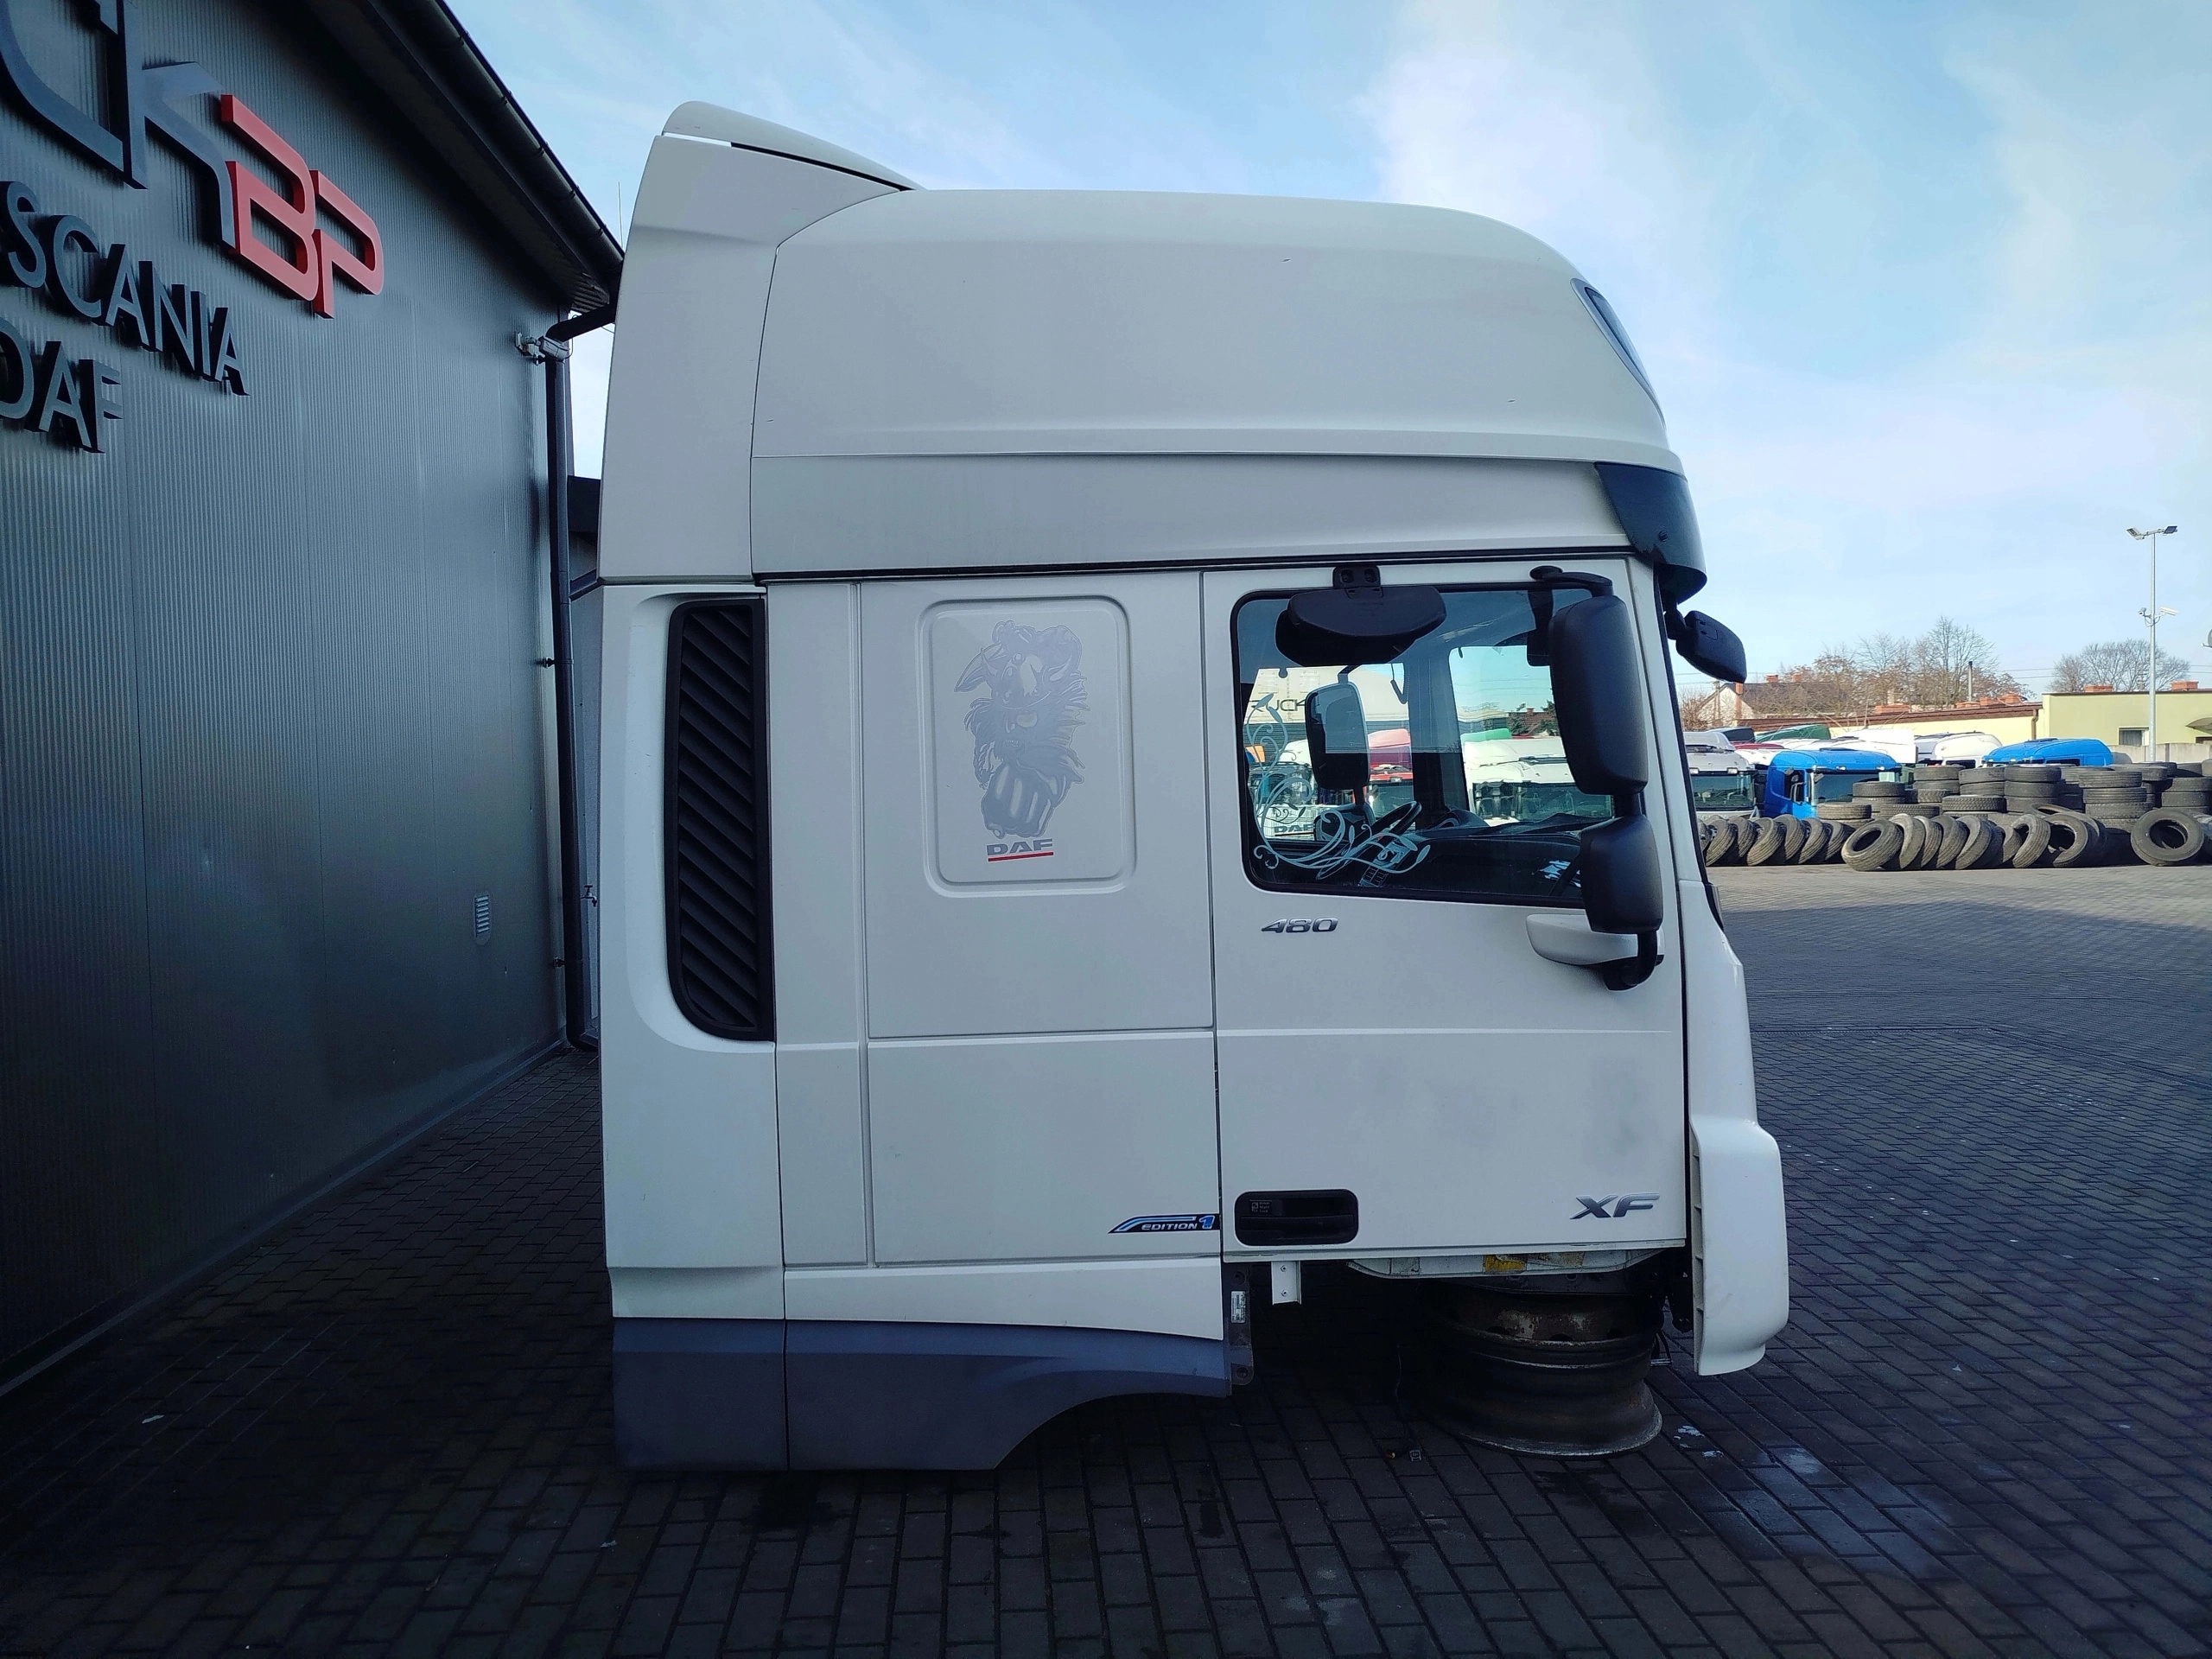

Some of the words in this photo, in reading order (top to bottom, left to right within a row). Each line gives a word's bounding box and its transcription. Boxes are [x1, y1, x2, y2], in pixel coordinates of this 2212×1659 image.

[2, 181, 250, 396] SCANIA
[1274, 823, 1315, 834] DAF
[987, 838, 1053, 856] DAF
[1261, 918, 1338, 933] 480
[1569, 1192, 1661, 1220] XF
[1199, 1215, 1216, 1230] 1
